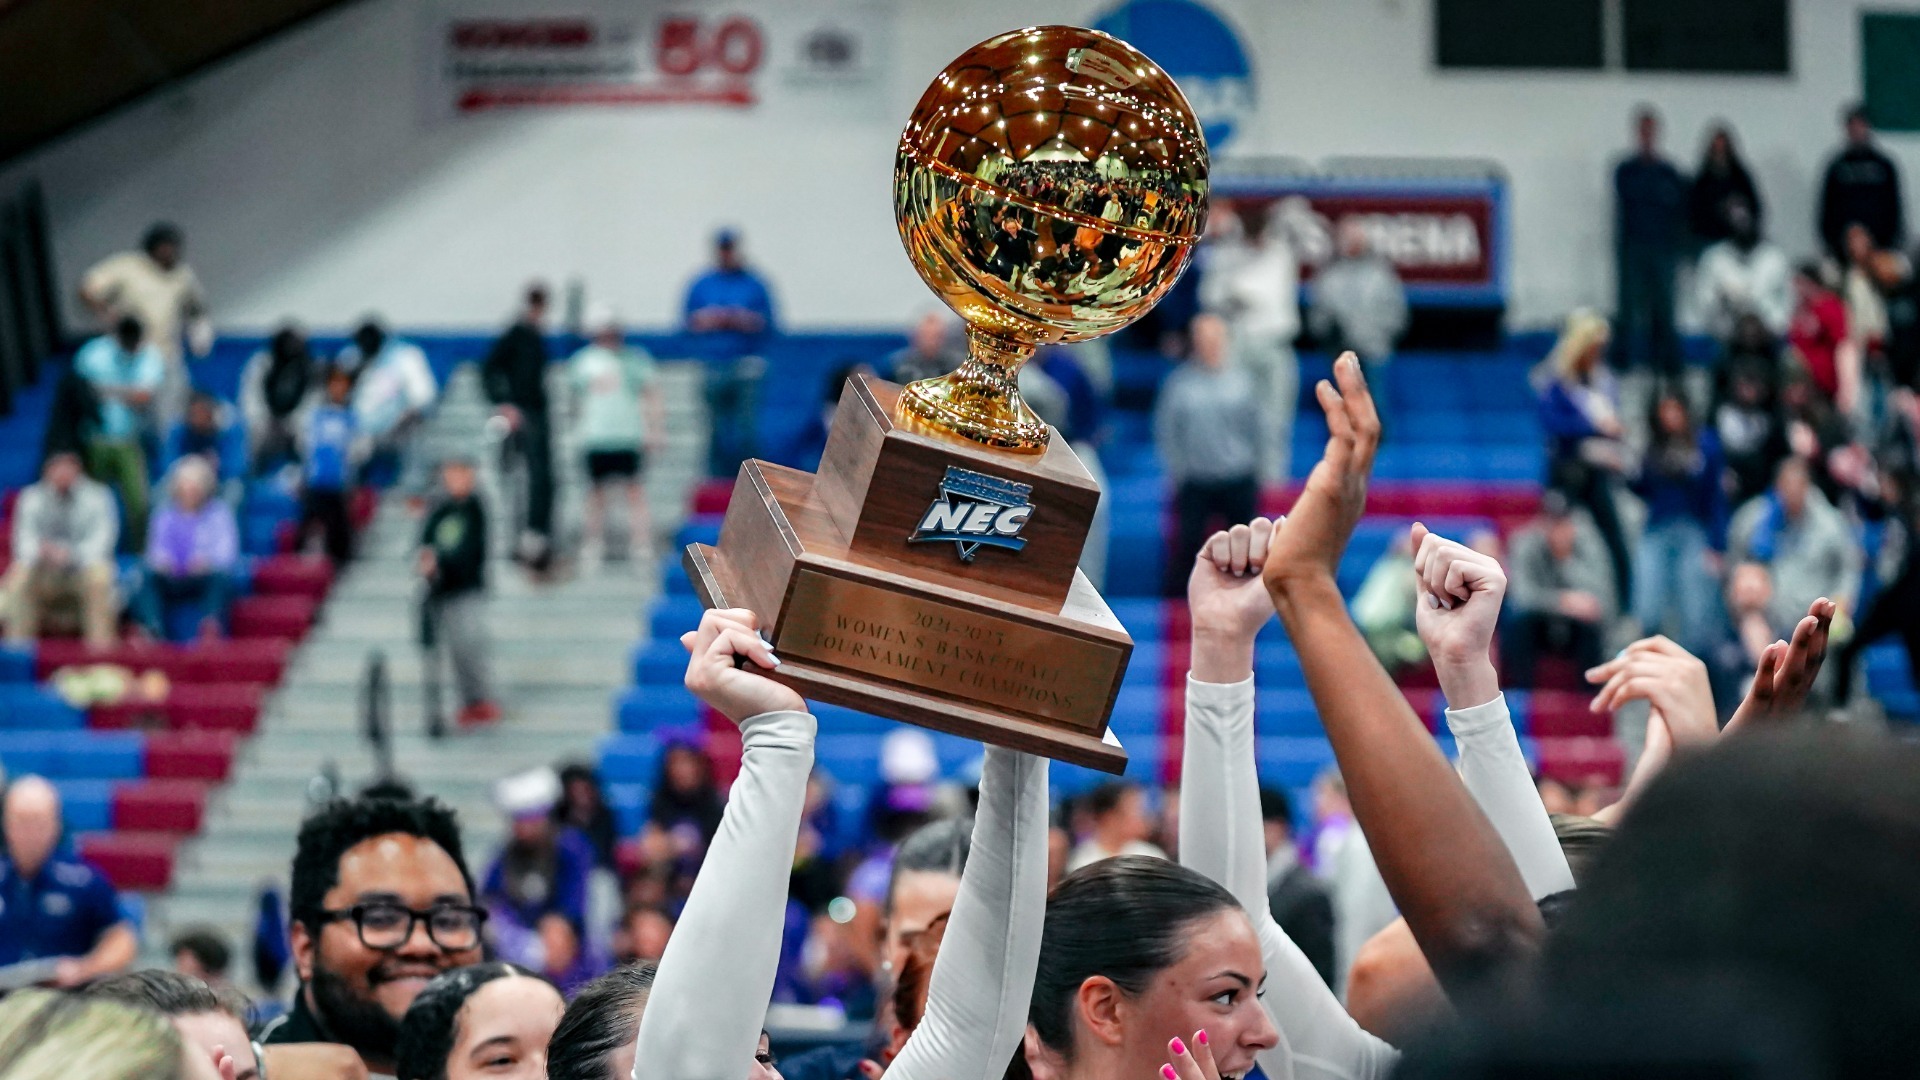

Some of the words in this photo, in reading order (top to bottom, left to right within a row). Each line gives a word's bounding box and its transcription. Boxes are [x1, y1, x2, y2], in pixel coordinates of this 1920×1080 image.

[656, 15, 763, 78] 50
[920, 502, 1033, 534] NEC
[813, 632, 951, 678] TOURNAMENT
[959, 668, 1075, 710] CHAMPIONS
[936, 639, 1062, 684] BASKETBALL
